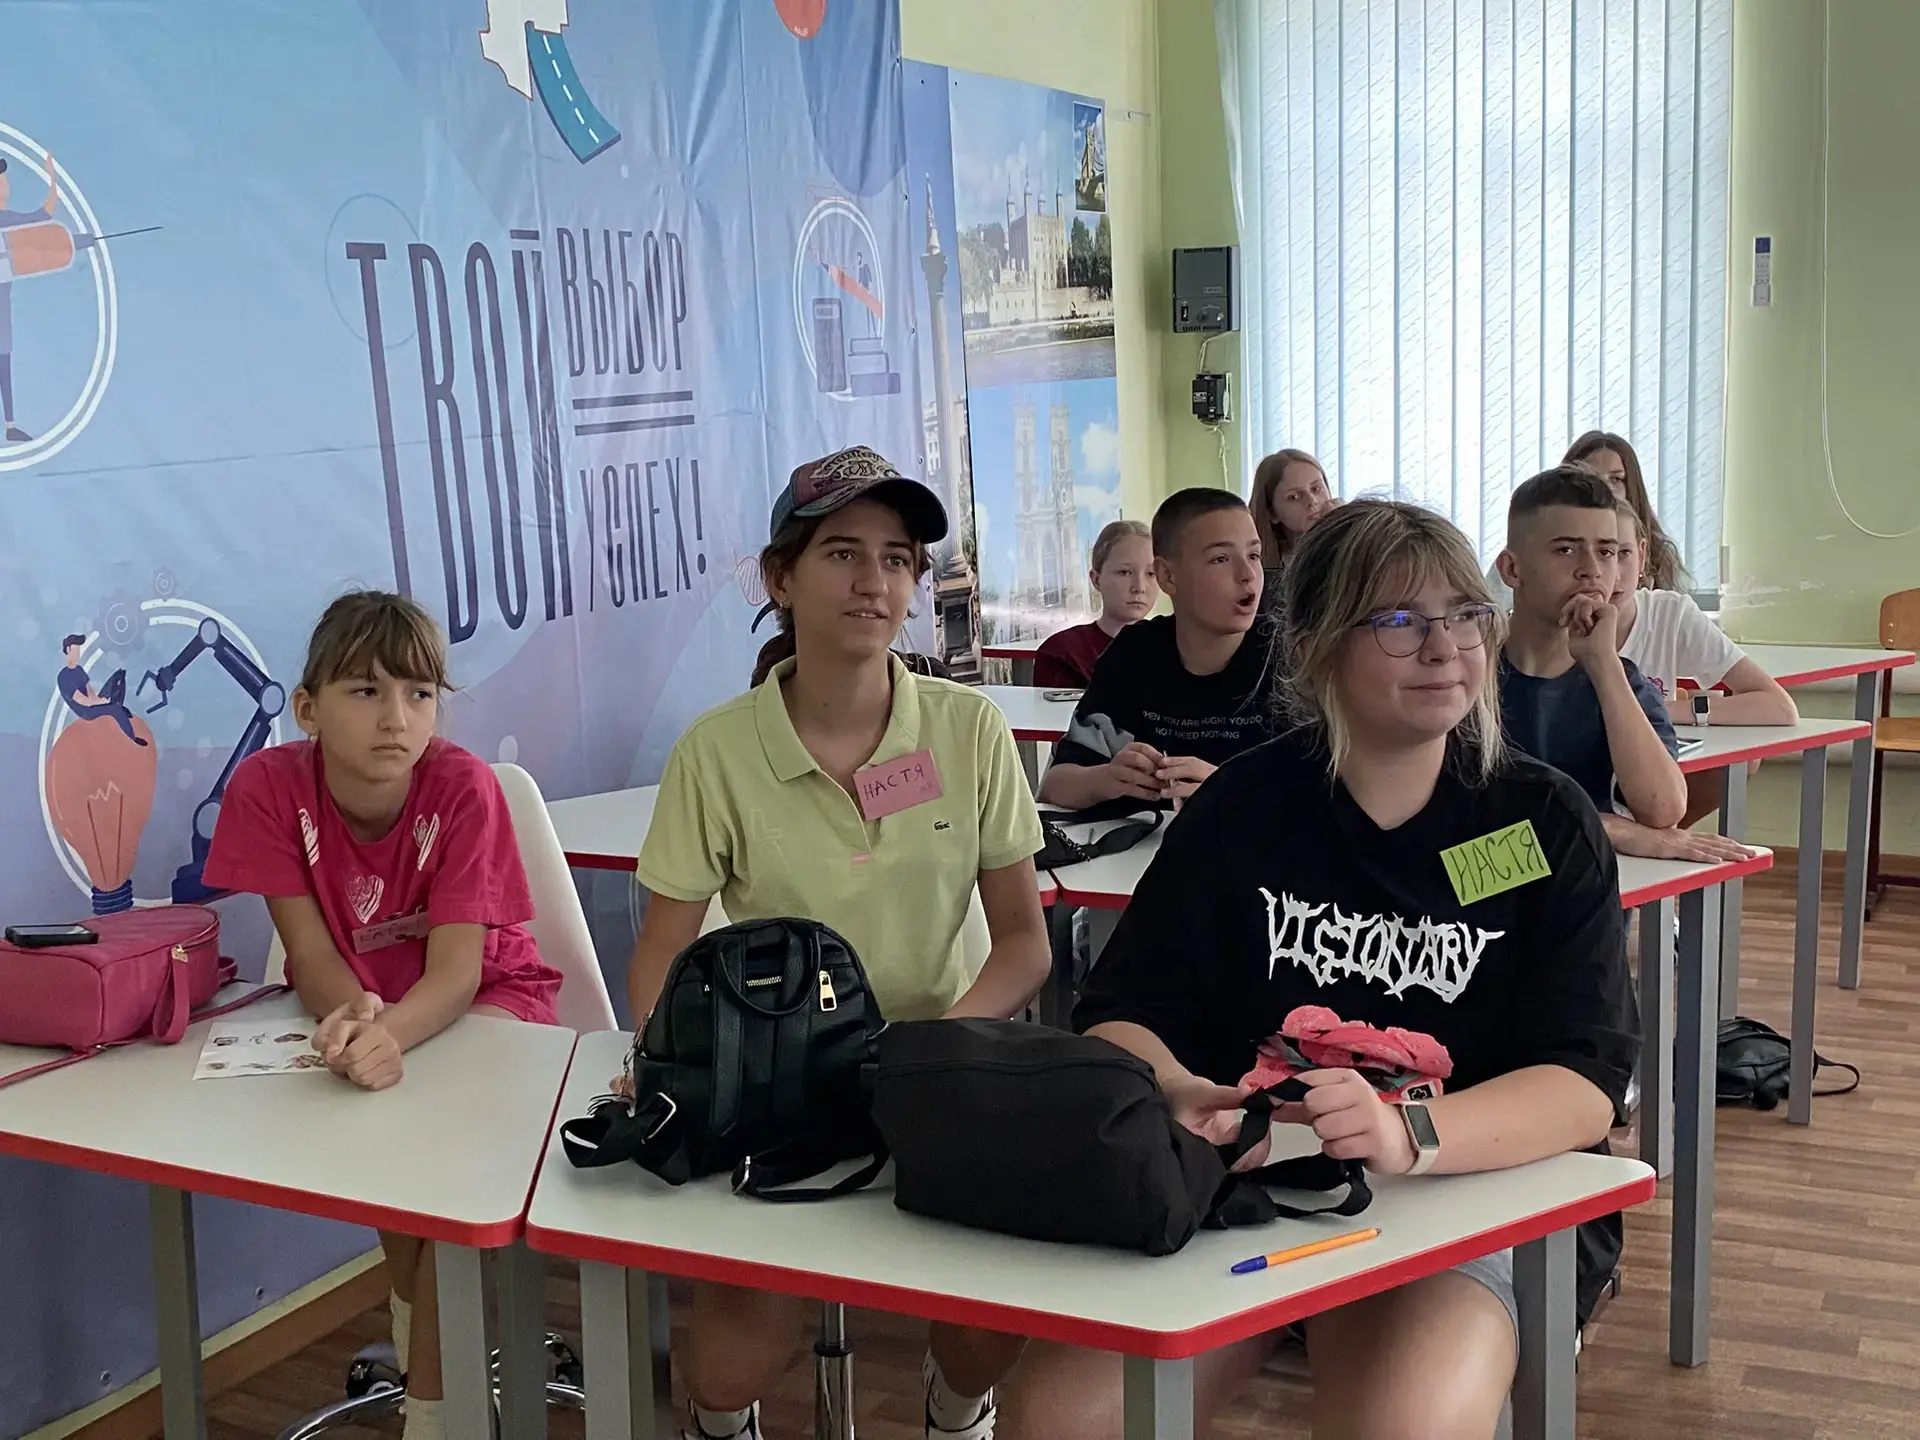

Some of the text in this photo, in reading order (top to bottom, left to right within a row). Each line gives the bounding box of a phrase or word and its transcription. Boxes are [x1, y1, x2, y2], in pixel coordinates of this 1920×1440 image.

[557, 227, 687, 377] ВЫБОР
[346, 229, 573, 645] ТВОЙ
[580, 457, 707, 612] УСПЕХ!
[1155, 727, 1174, 736] NOT
[1181, 719, 1200, 727] ARE
[1229, 717, 1249, 726] YOU
[1250, 714, 1263, 724] DO
[863, 763, 924, 800] НАСТЯ
[1449, 825, 1543, 901] НАСТЯ
[1258, 887, 1505, 1003] VISIONARY
